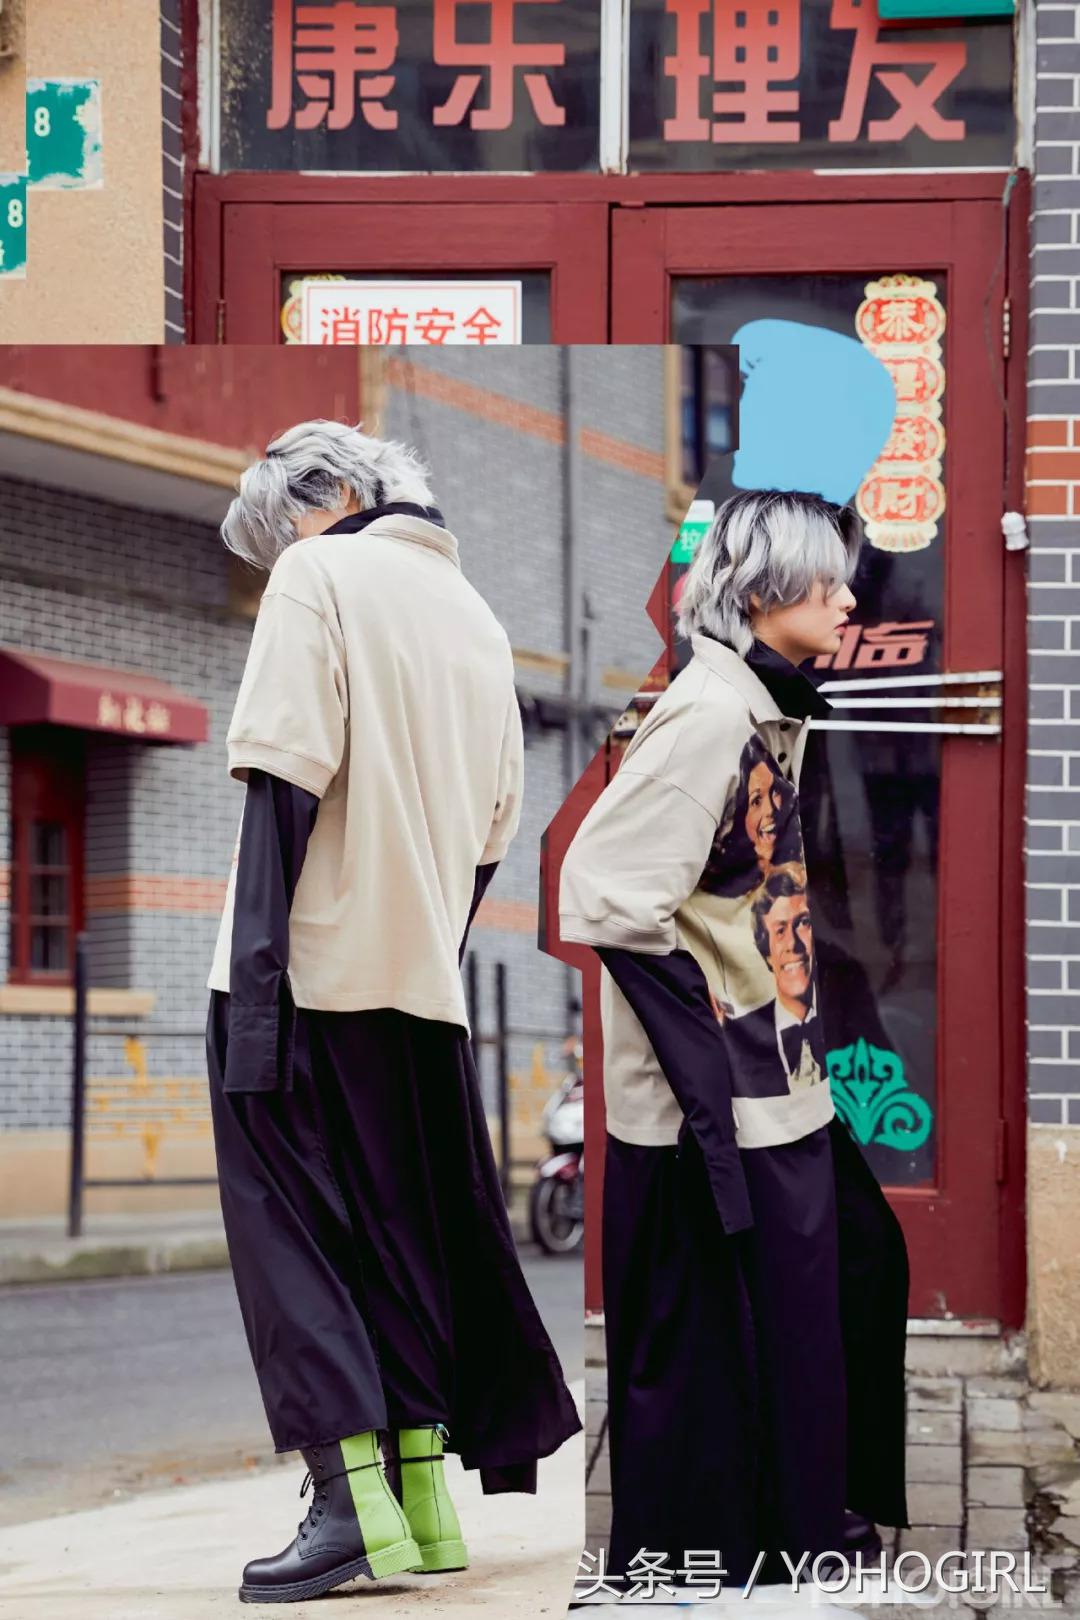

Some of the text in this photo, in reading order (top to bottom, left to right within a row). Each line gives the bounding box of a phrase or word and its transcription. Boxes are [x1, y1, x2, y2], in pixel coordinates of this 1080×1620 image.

[267, 0, 967, 143] 康乐 理发
[34, 107, 50, 136] 8
[7, 199, 23, 228] 8
[320, 307, 501, 344] 消防安全
